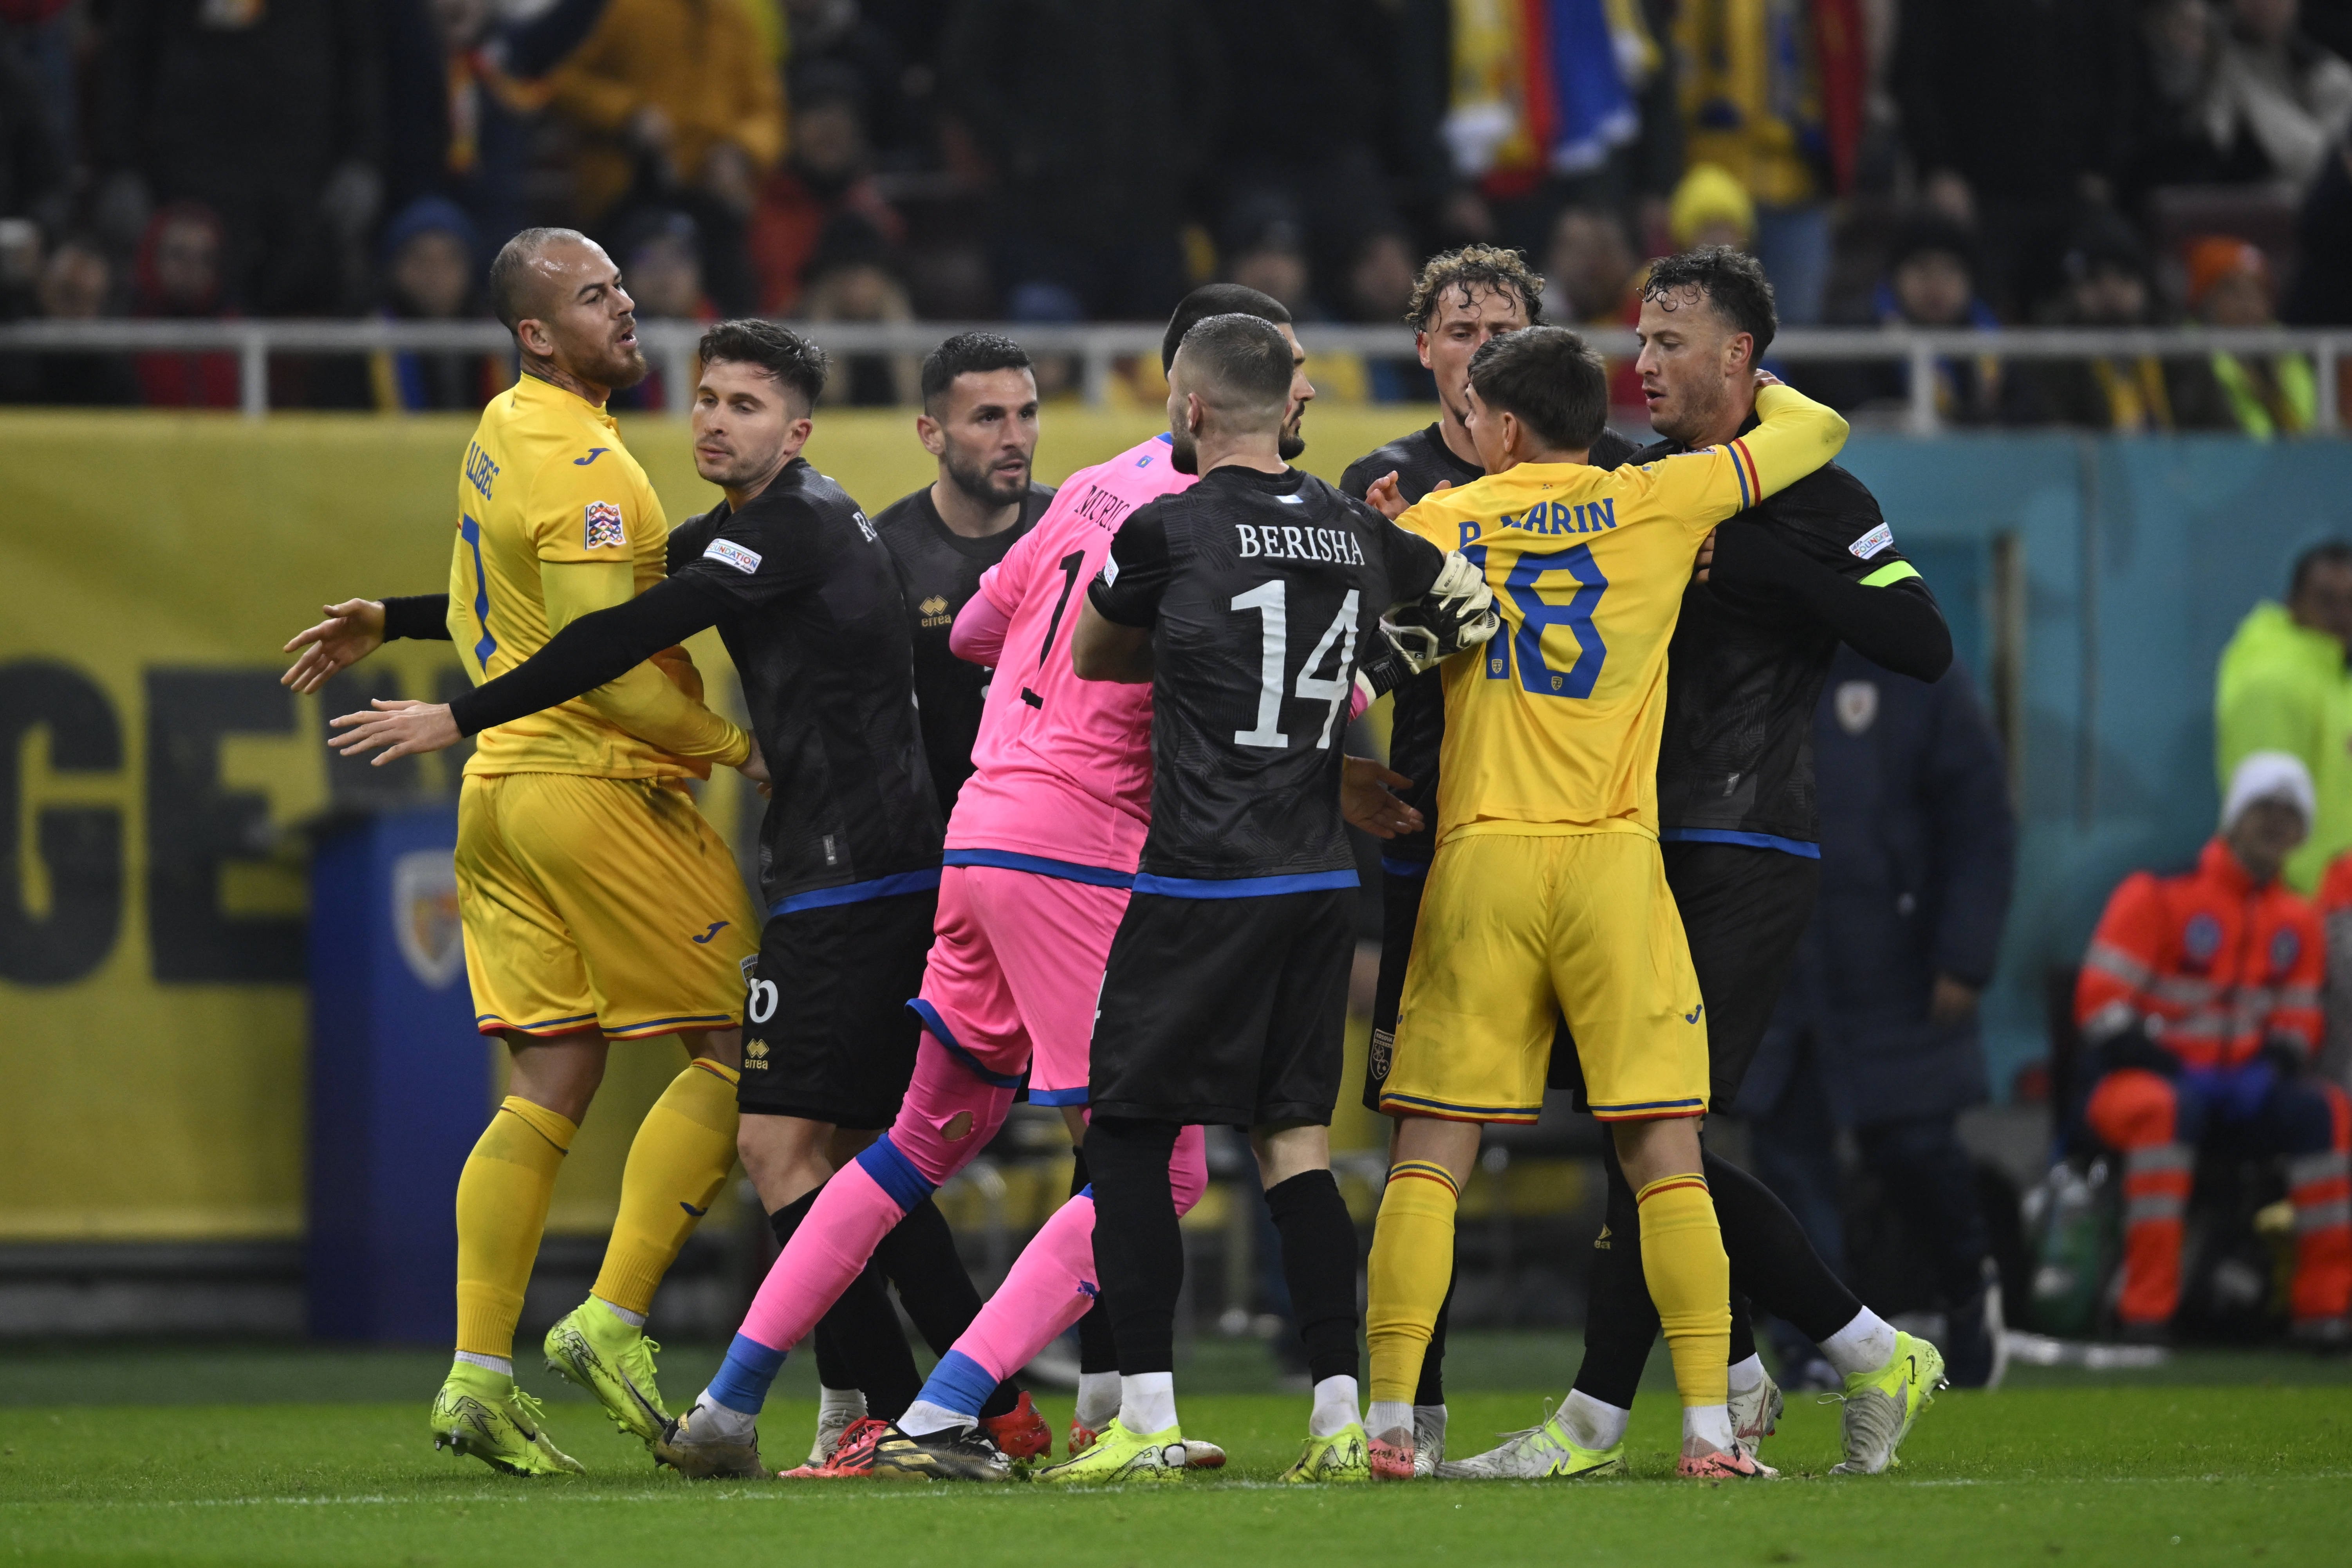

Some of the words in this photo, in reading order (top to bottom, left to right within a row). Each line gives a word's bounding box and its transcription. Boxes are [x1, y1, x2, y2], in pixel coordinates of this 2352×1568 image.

[1074, 485, 1130, 531] MURIC
[707, 544, 757, 568] FOUNDATION
[1235, 524, 1365, 566] BERISHA
[1851, 541, 1863, 551] UEFA
[1444, 563, 1460, 588] SELLS
[921, 614, 952, 627] errea
[1020, 549, 1086, 710] 1
[1231, 579, 1360, 749] 14
[1376, 1032, 1393, 1043] KOSOVA
[745, 1059, 768, 1070] errea
